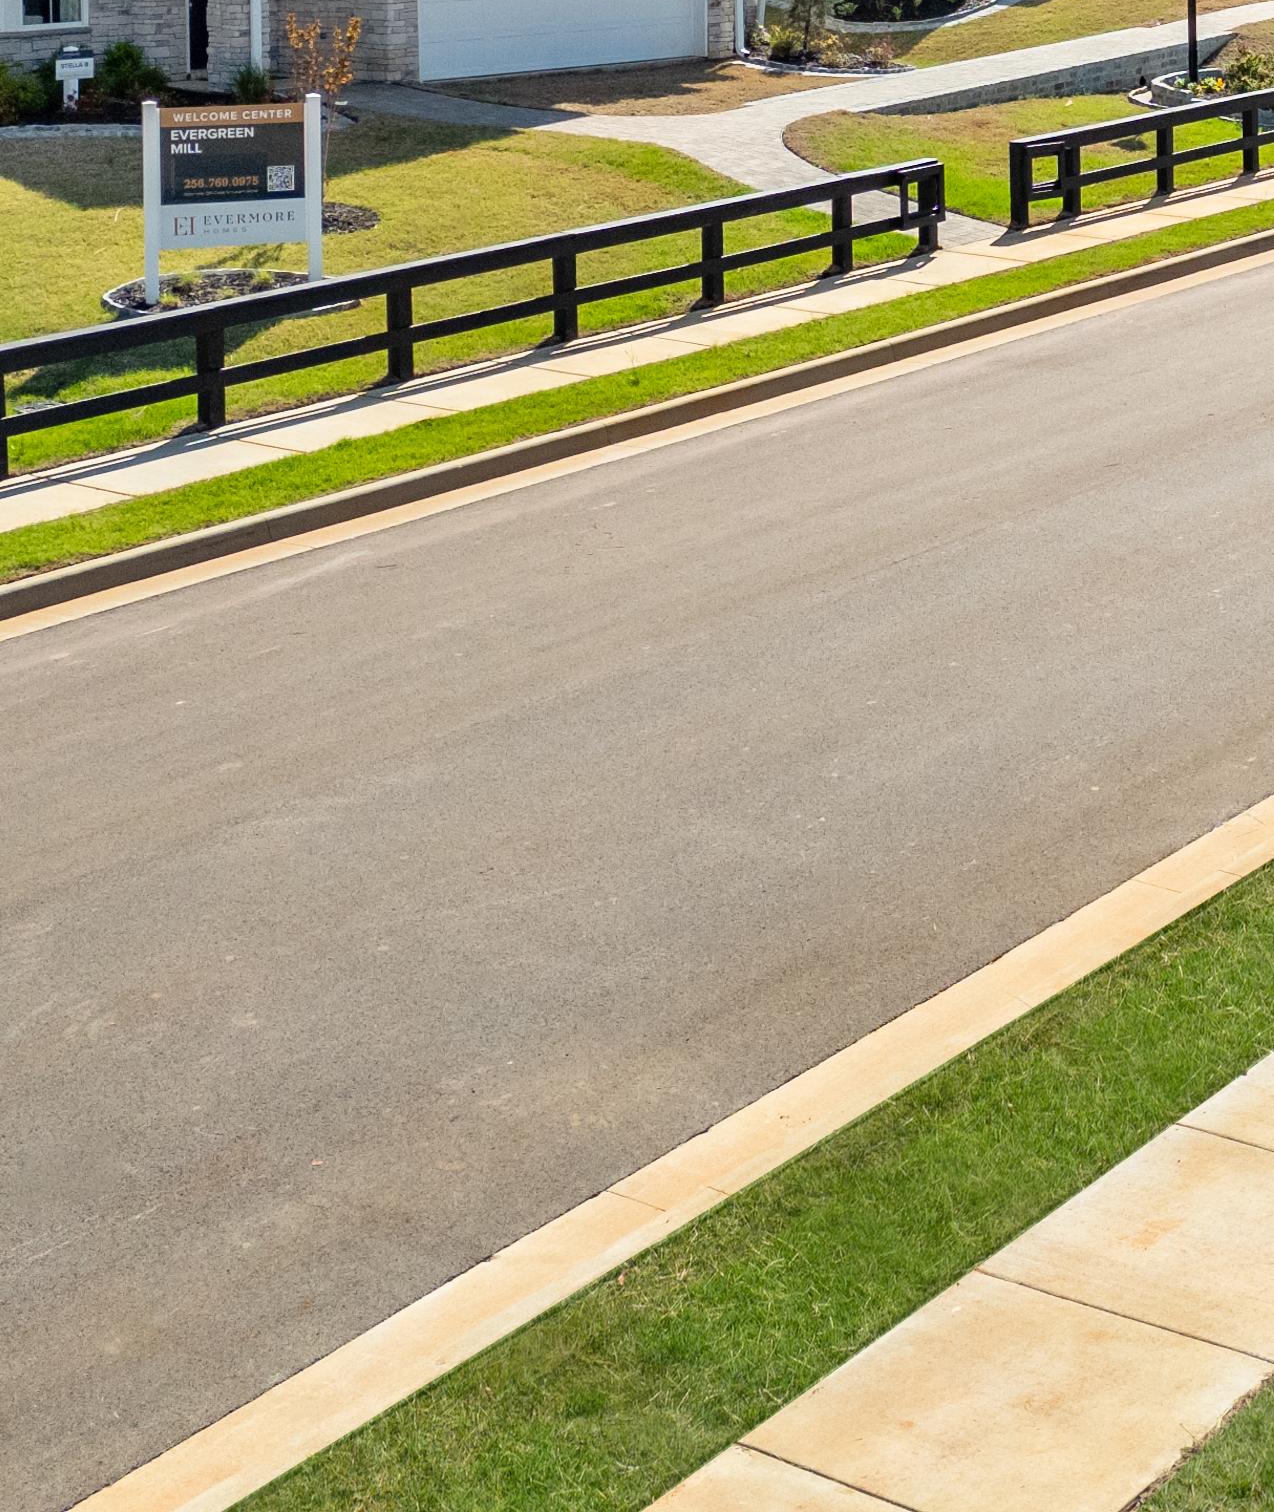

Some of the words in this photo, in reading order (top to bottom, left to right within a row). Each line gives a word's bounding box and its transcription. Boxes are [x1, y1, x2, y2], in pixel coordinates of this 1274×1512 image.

[172, 111, 238, 122] WELCOME
[242, 108, 293, 120] CENTER
[170, 126, 255, 141] EVERGREEN
[170, 142, 203, 154] MILL
[203, 210, 296, 226] EVERMORE
[203, 226, 248, 234] HOMES
